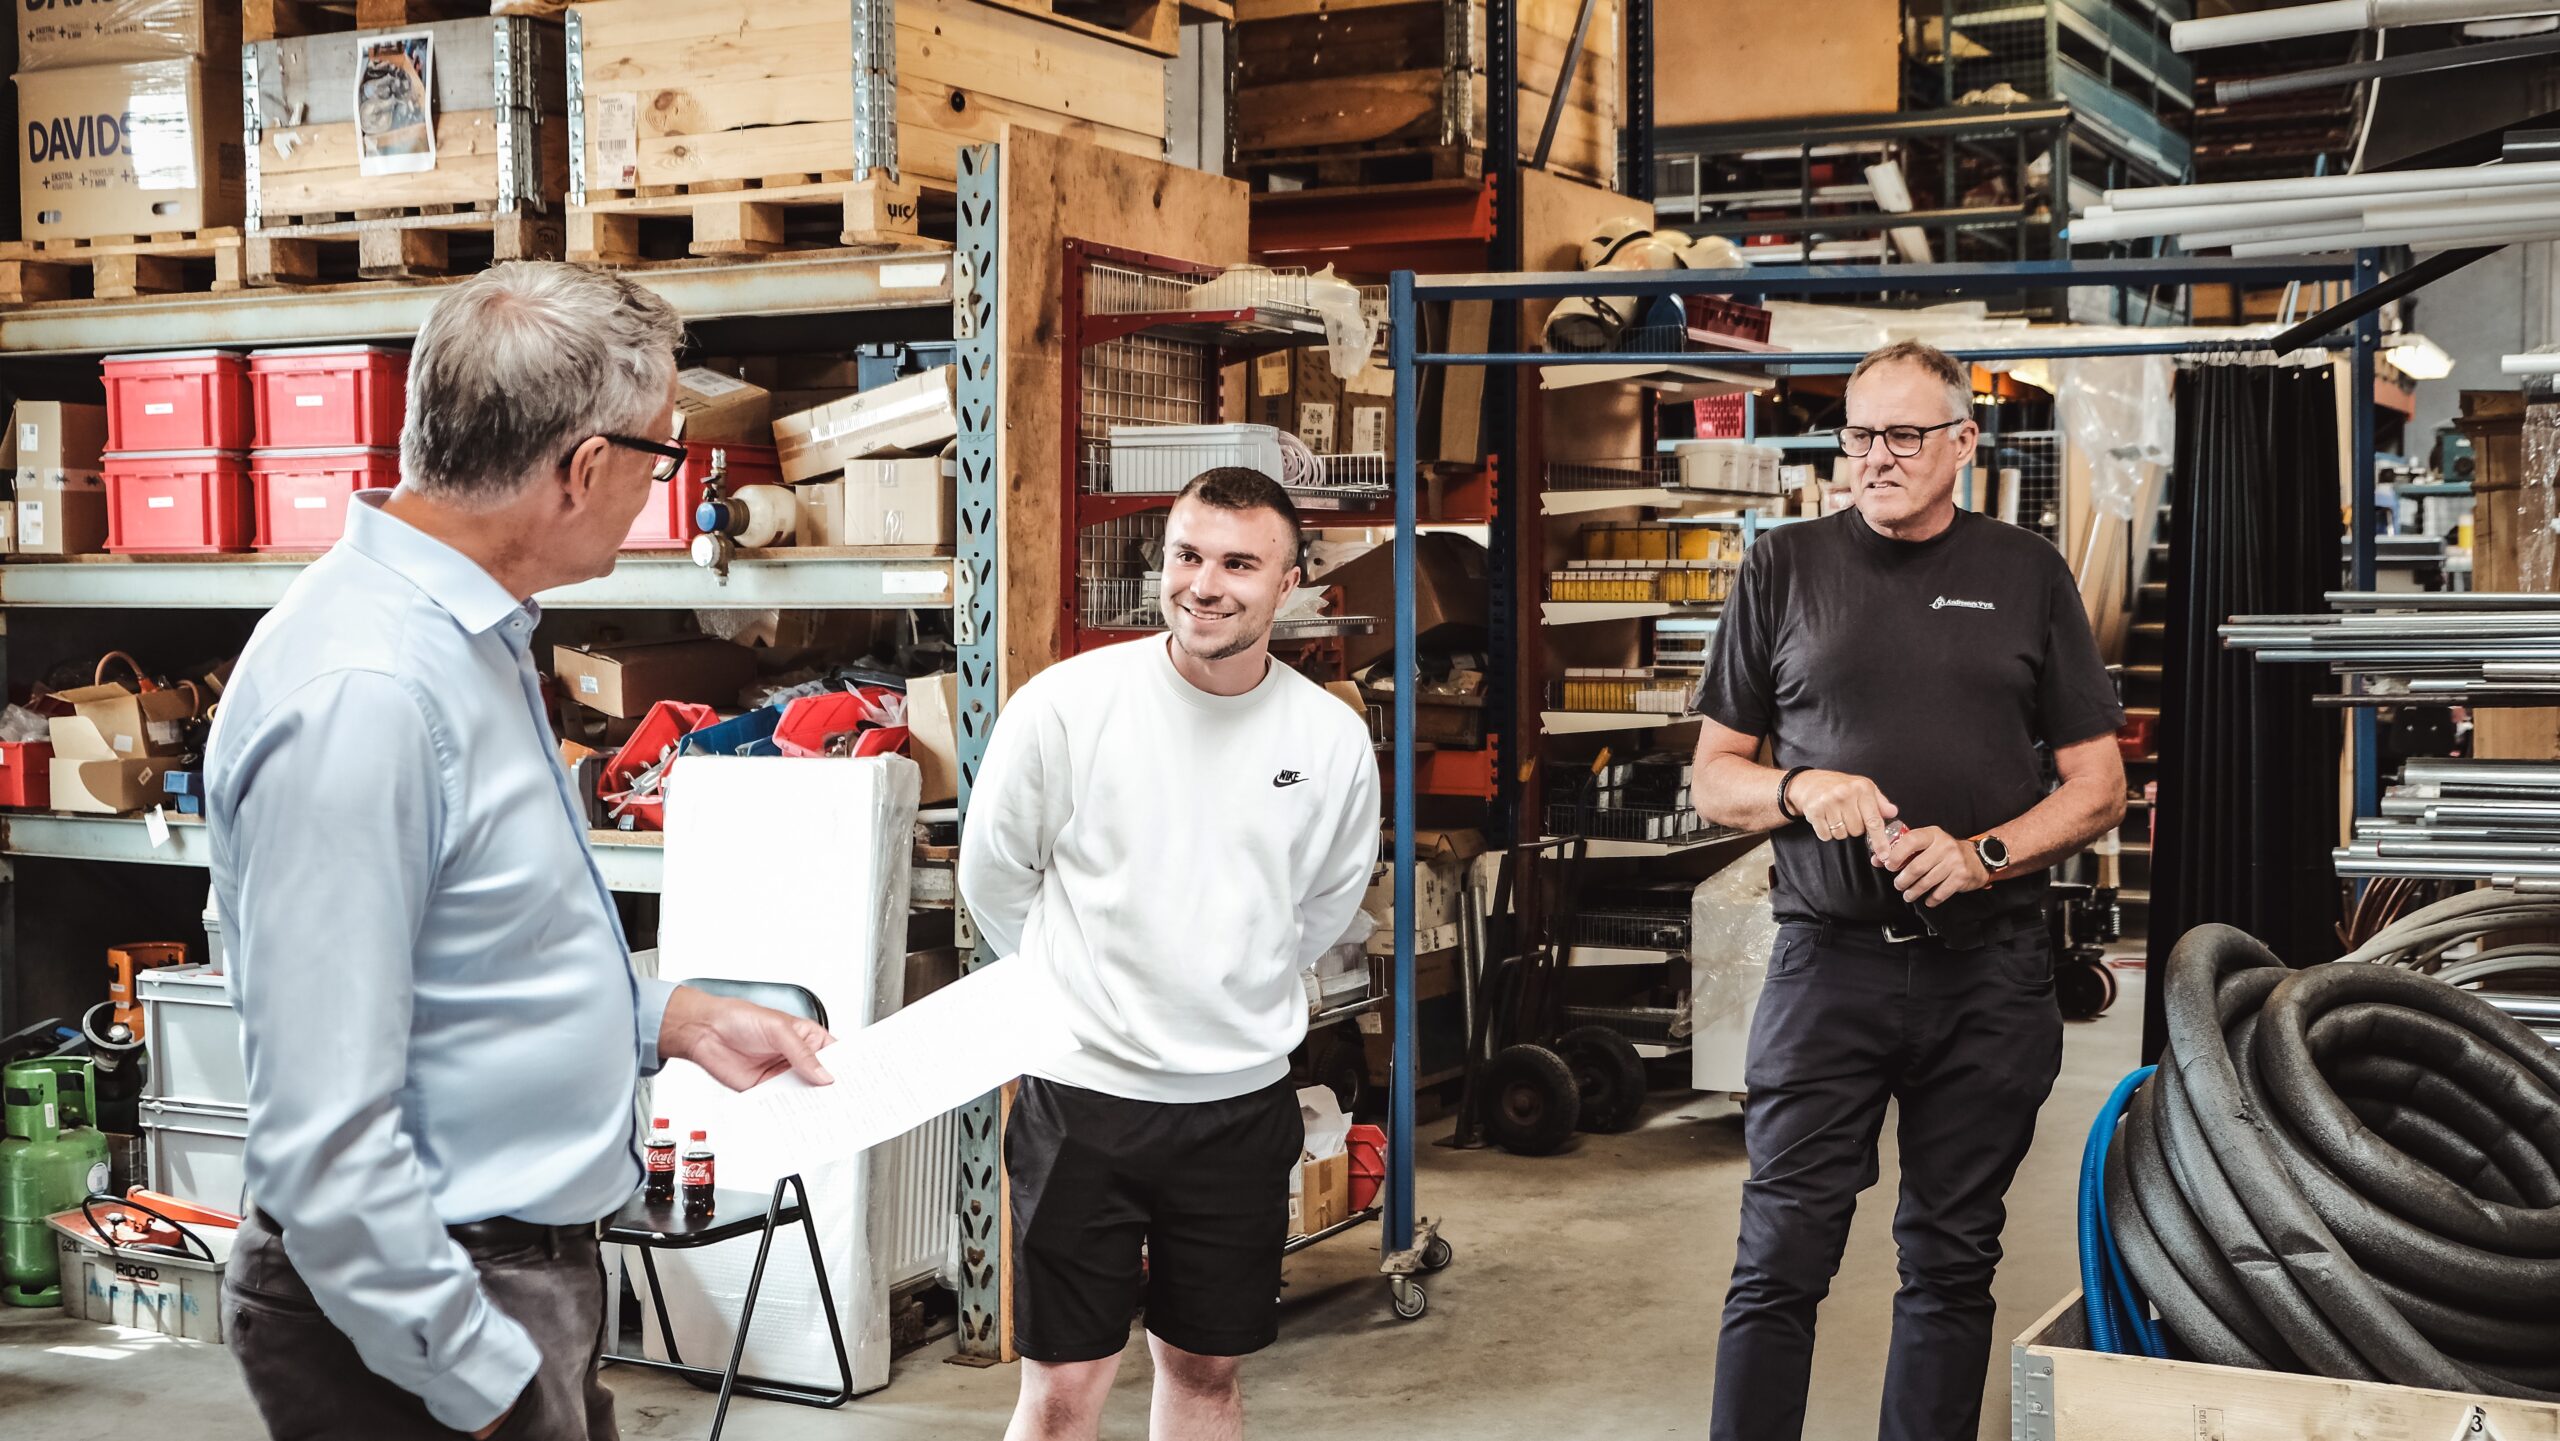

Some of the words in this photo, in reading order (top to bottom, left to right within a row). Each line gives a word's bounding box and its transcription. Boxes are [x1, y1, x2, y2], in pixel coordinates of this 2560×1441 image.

[51, 171, 73, 182] EKSTRA
[95, 178, 106, 188] MM
[1278, 769, 1301, 782] NIKE
[115, 1261, 160, 1281] RIDGID
[2470, 1414, 2483, 1433] 3
